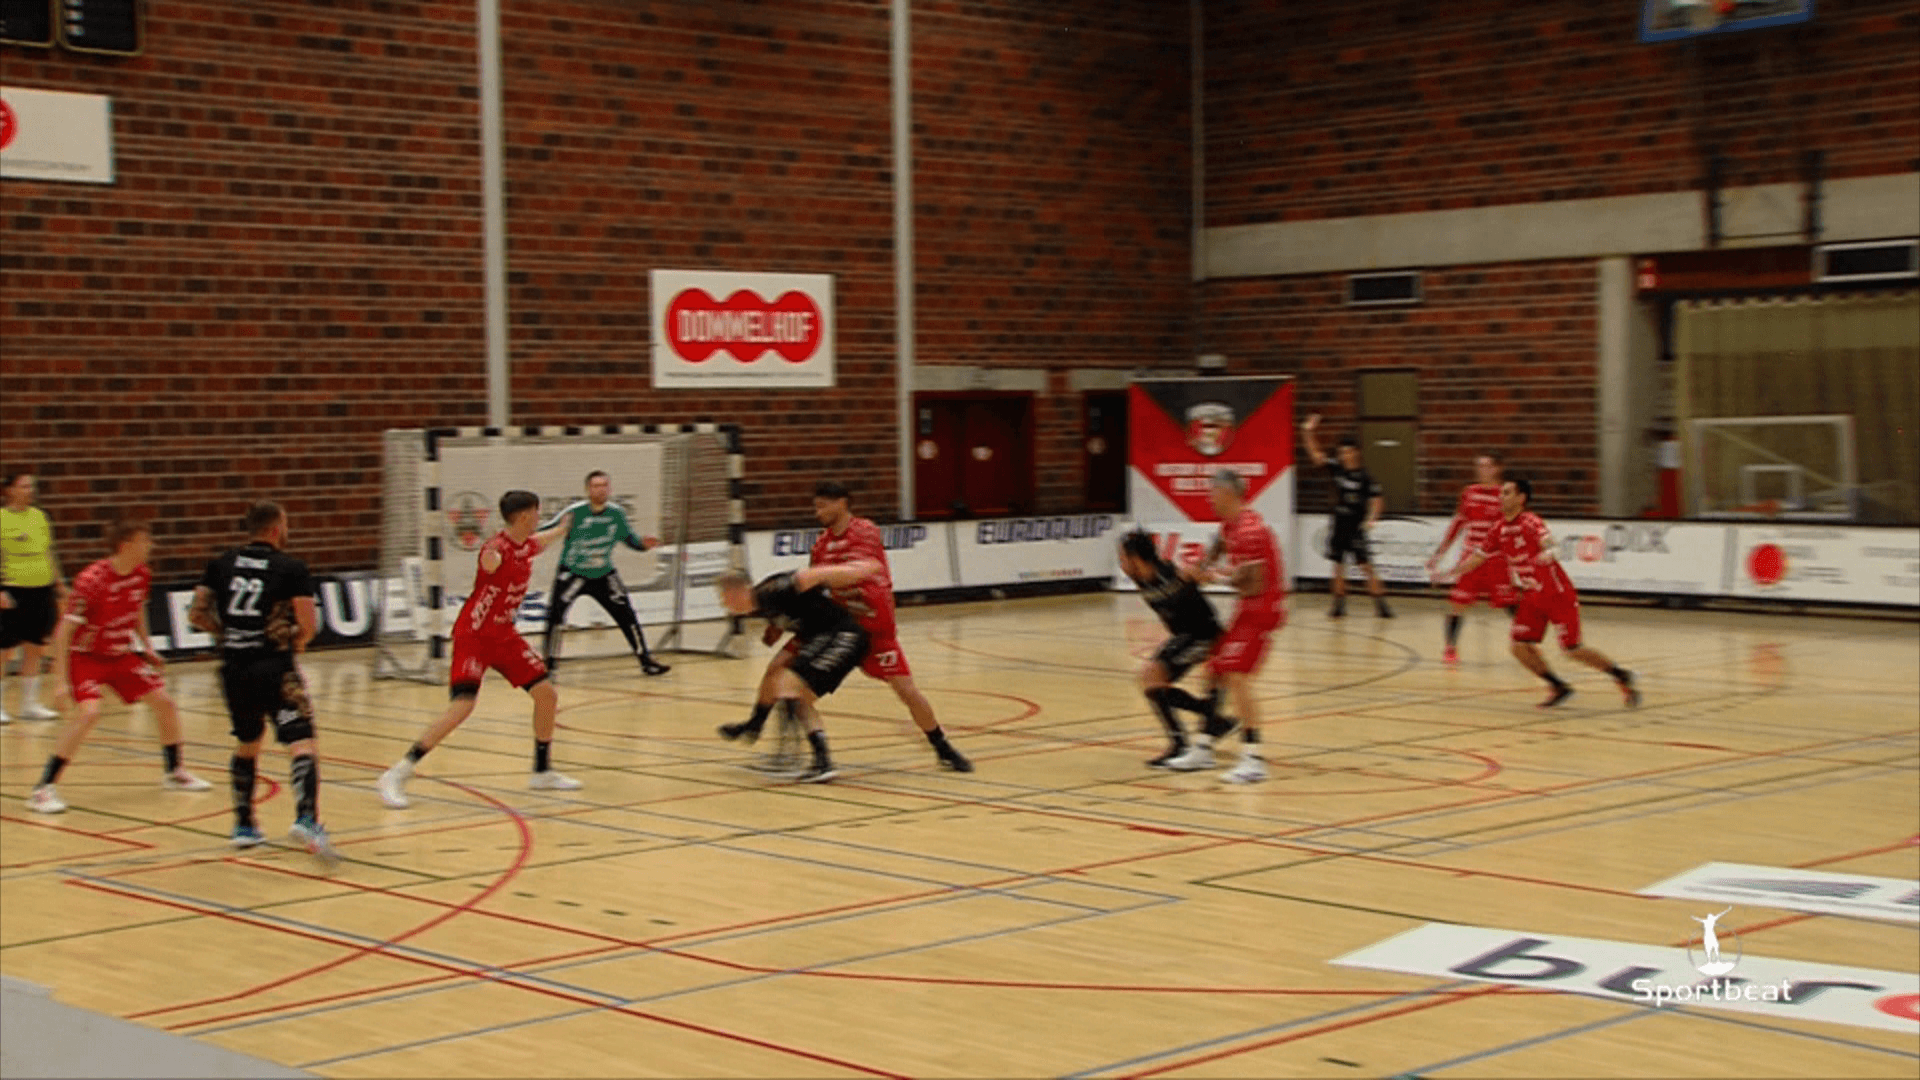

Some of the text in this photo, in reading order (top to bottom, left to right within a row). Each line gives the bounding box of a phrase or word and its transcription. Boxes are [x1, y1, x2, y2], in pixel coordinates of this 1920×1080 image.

[676, 309, 816, 343] DOMMELHOF
[772, 524, 928, 557] EUUIP
[226, 576, 264, 617] 22
